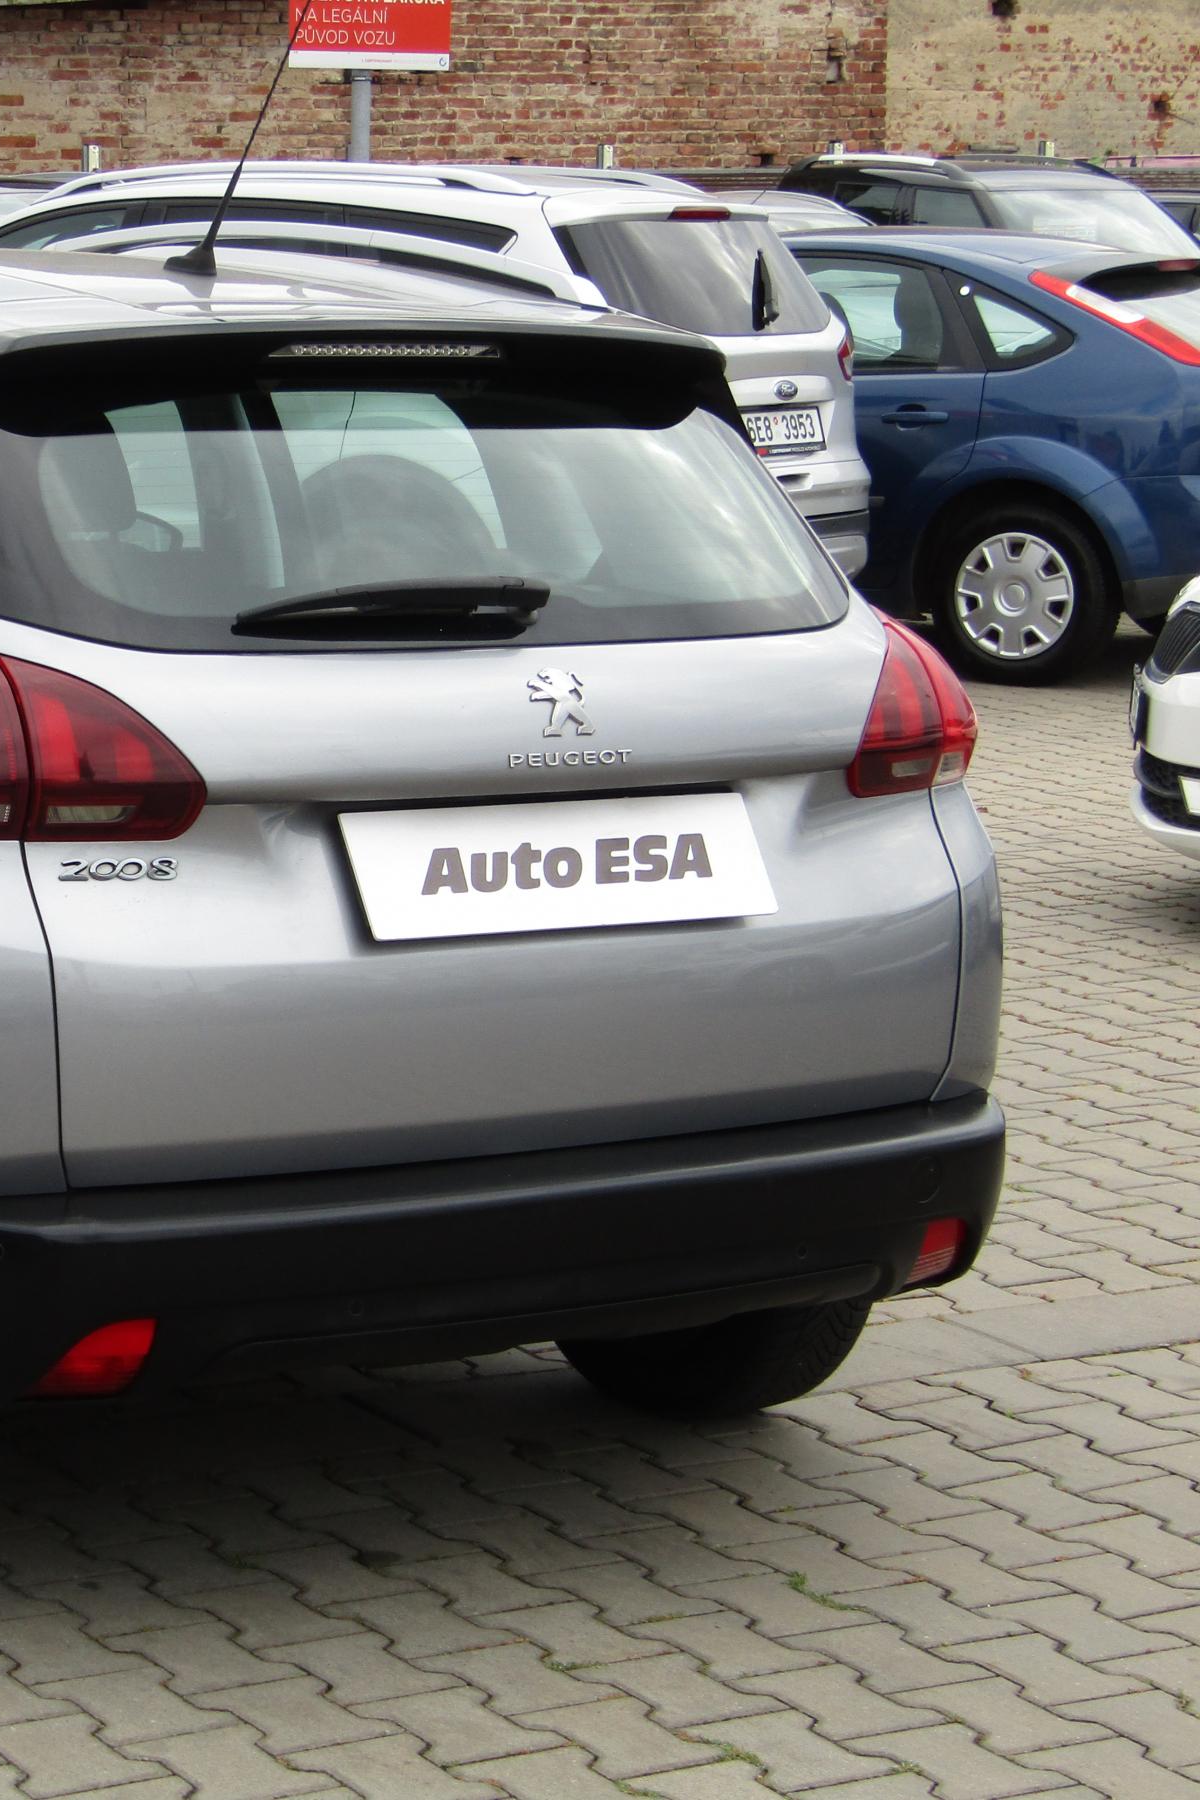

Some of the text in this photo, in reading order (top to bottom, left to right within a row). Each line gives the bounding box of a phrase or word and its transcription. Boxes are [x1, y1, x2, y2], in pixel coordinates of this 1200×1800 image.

[295, 8, 388, 24] NA LEGÁLNÍ
[295, 25, 395, 46] PŮVOD VOZU
[746, 413, 816, 443] 6E8 3953
[508, 747, 632, 768] PEUGEOT
[58, 856, 180, 882] 2008
[420, 832, 714, 897] Auto ESA
